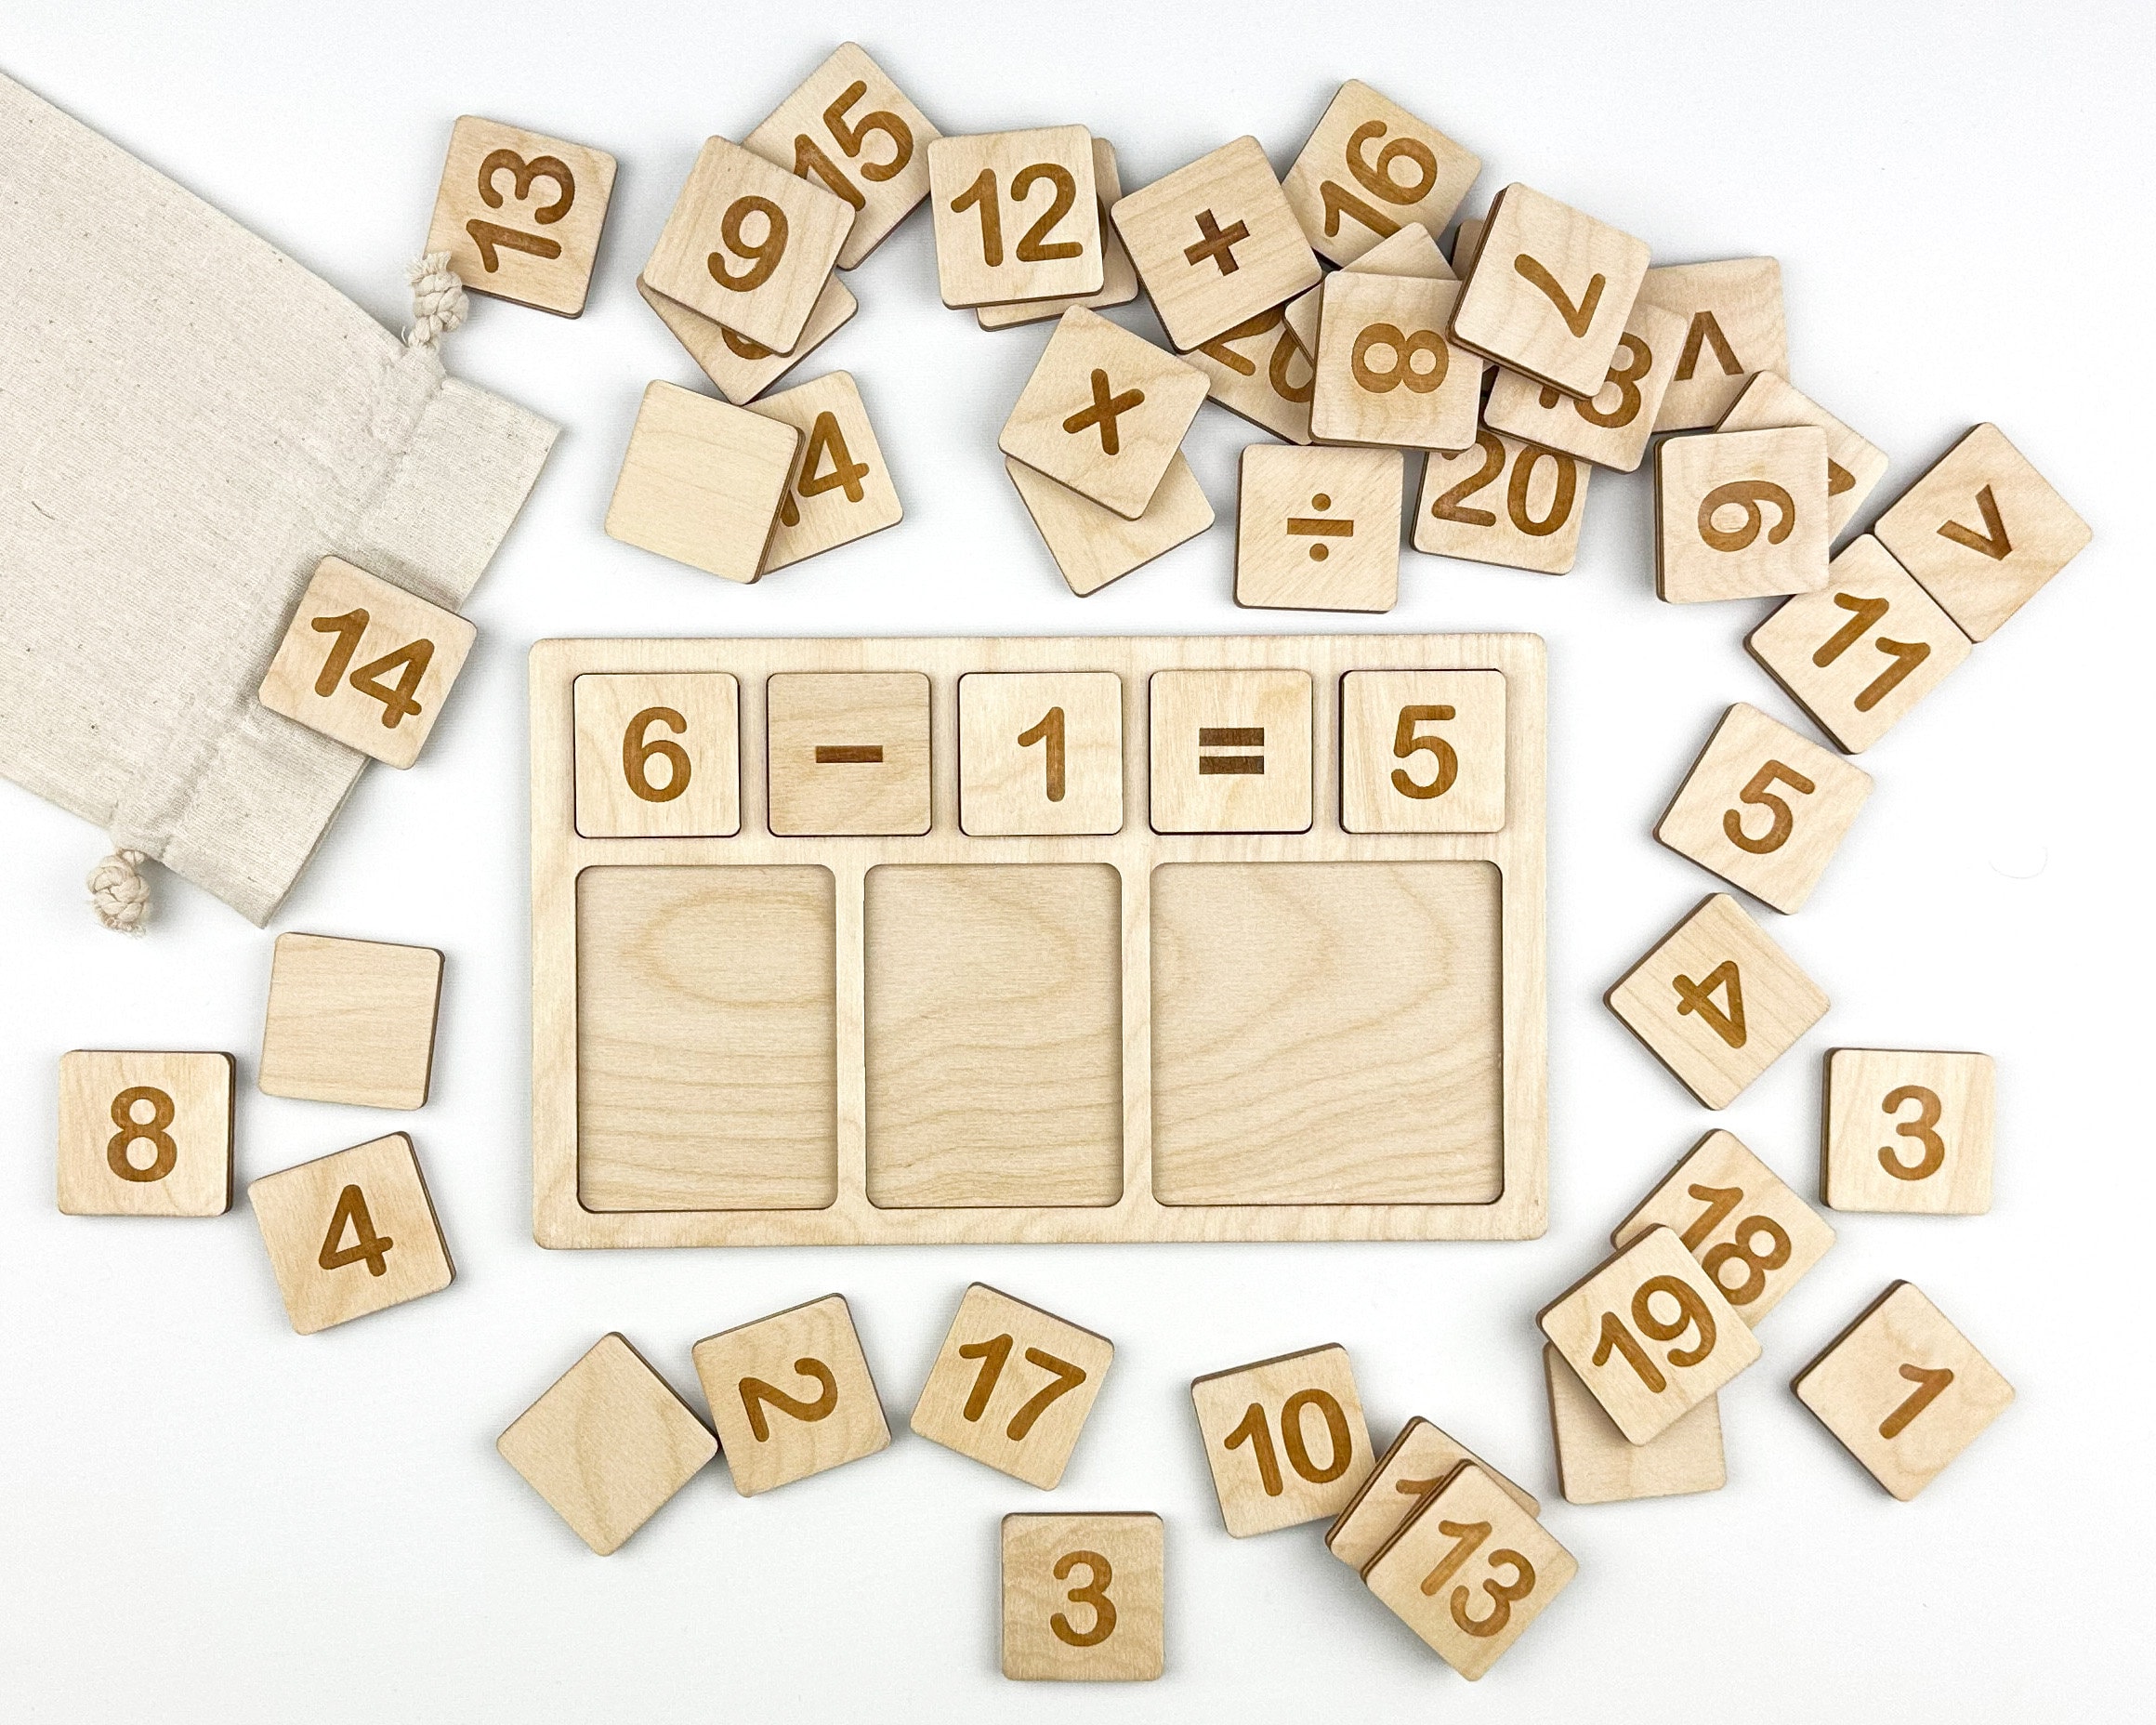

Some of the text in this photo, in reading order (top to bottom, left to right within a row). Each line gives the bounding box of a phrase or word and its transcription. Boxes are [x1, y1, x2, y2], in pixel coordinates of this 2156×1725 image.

[794, 81, 914, 210] 15
[1321, 120, 1438, 238] 16
[466, 149, 575, 273] 13
[707, 195, 789, 293] 9
[951, 163, 1084, 268] 12
[1351, 323, 1450, 394] 8
[1539, 332, 1653, 428] 8
[780, 410, 871, 528] 4
[1431, 429, 1578, 537] 20
[311, 608, 435, 729] 14
[1812, 592, 1932, 713] 11
[623, 706, 692, 803] 6
[1018, 708, 1066, 802] 1
[1391, 704, 1459, 800] 5
[1723, 759, 1816, 855] 5
[1673, 960, 1748, 1049] 4
[107, 1086, 177, 1182] 8
[1877, 1085, 1946, 1181] 3
[318, 1184, 394, 1277] 4
[1680, 1183, 1793, 1306] 18
[1592, 1275, 1717, 1394] 19
[738, 1358, 838, 1442] 2
[959, 1334, 1086, 1442] 17
[1878, 1363, 1954, 1441] 1
[1223, 1388, 1353, 1497] 10
[1050, 1550, 1118, 1648] 3
[1420, 1520, 1537, 1639] 13
